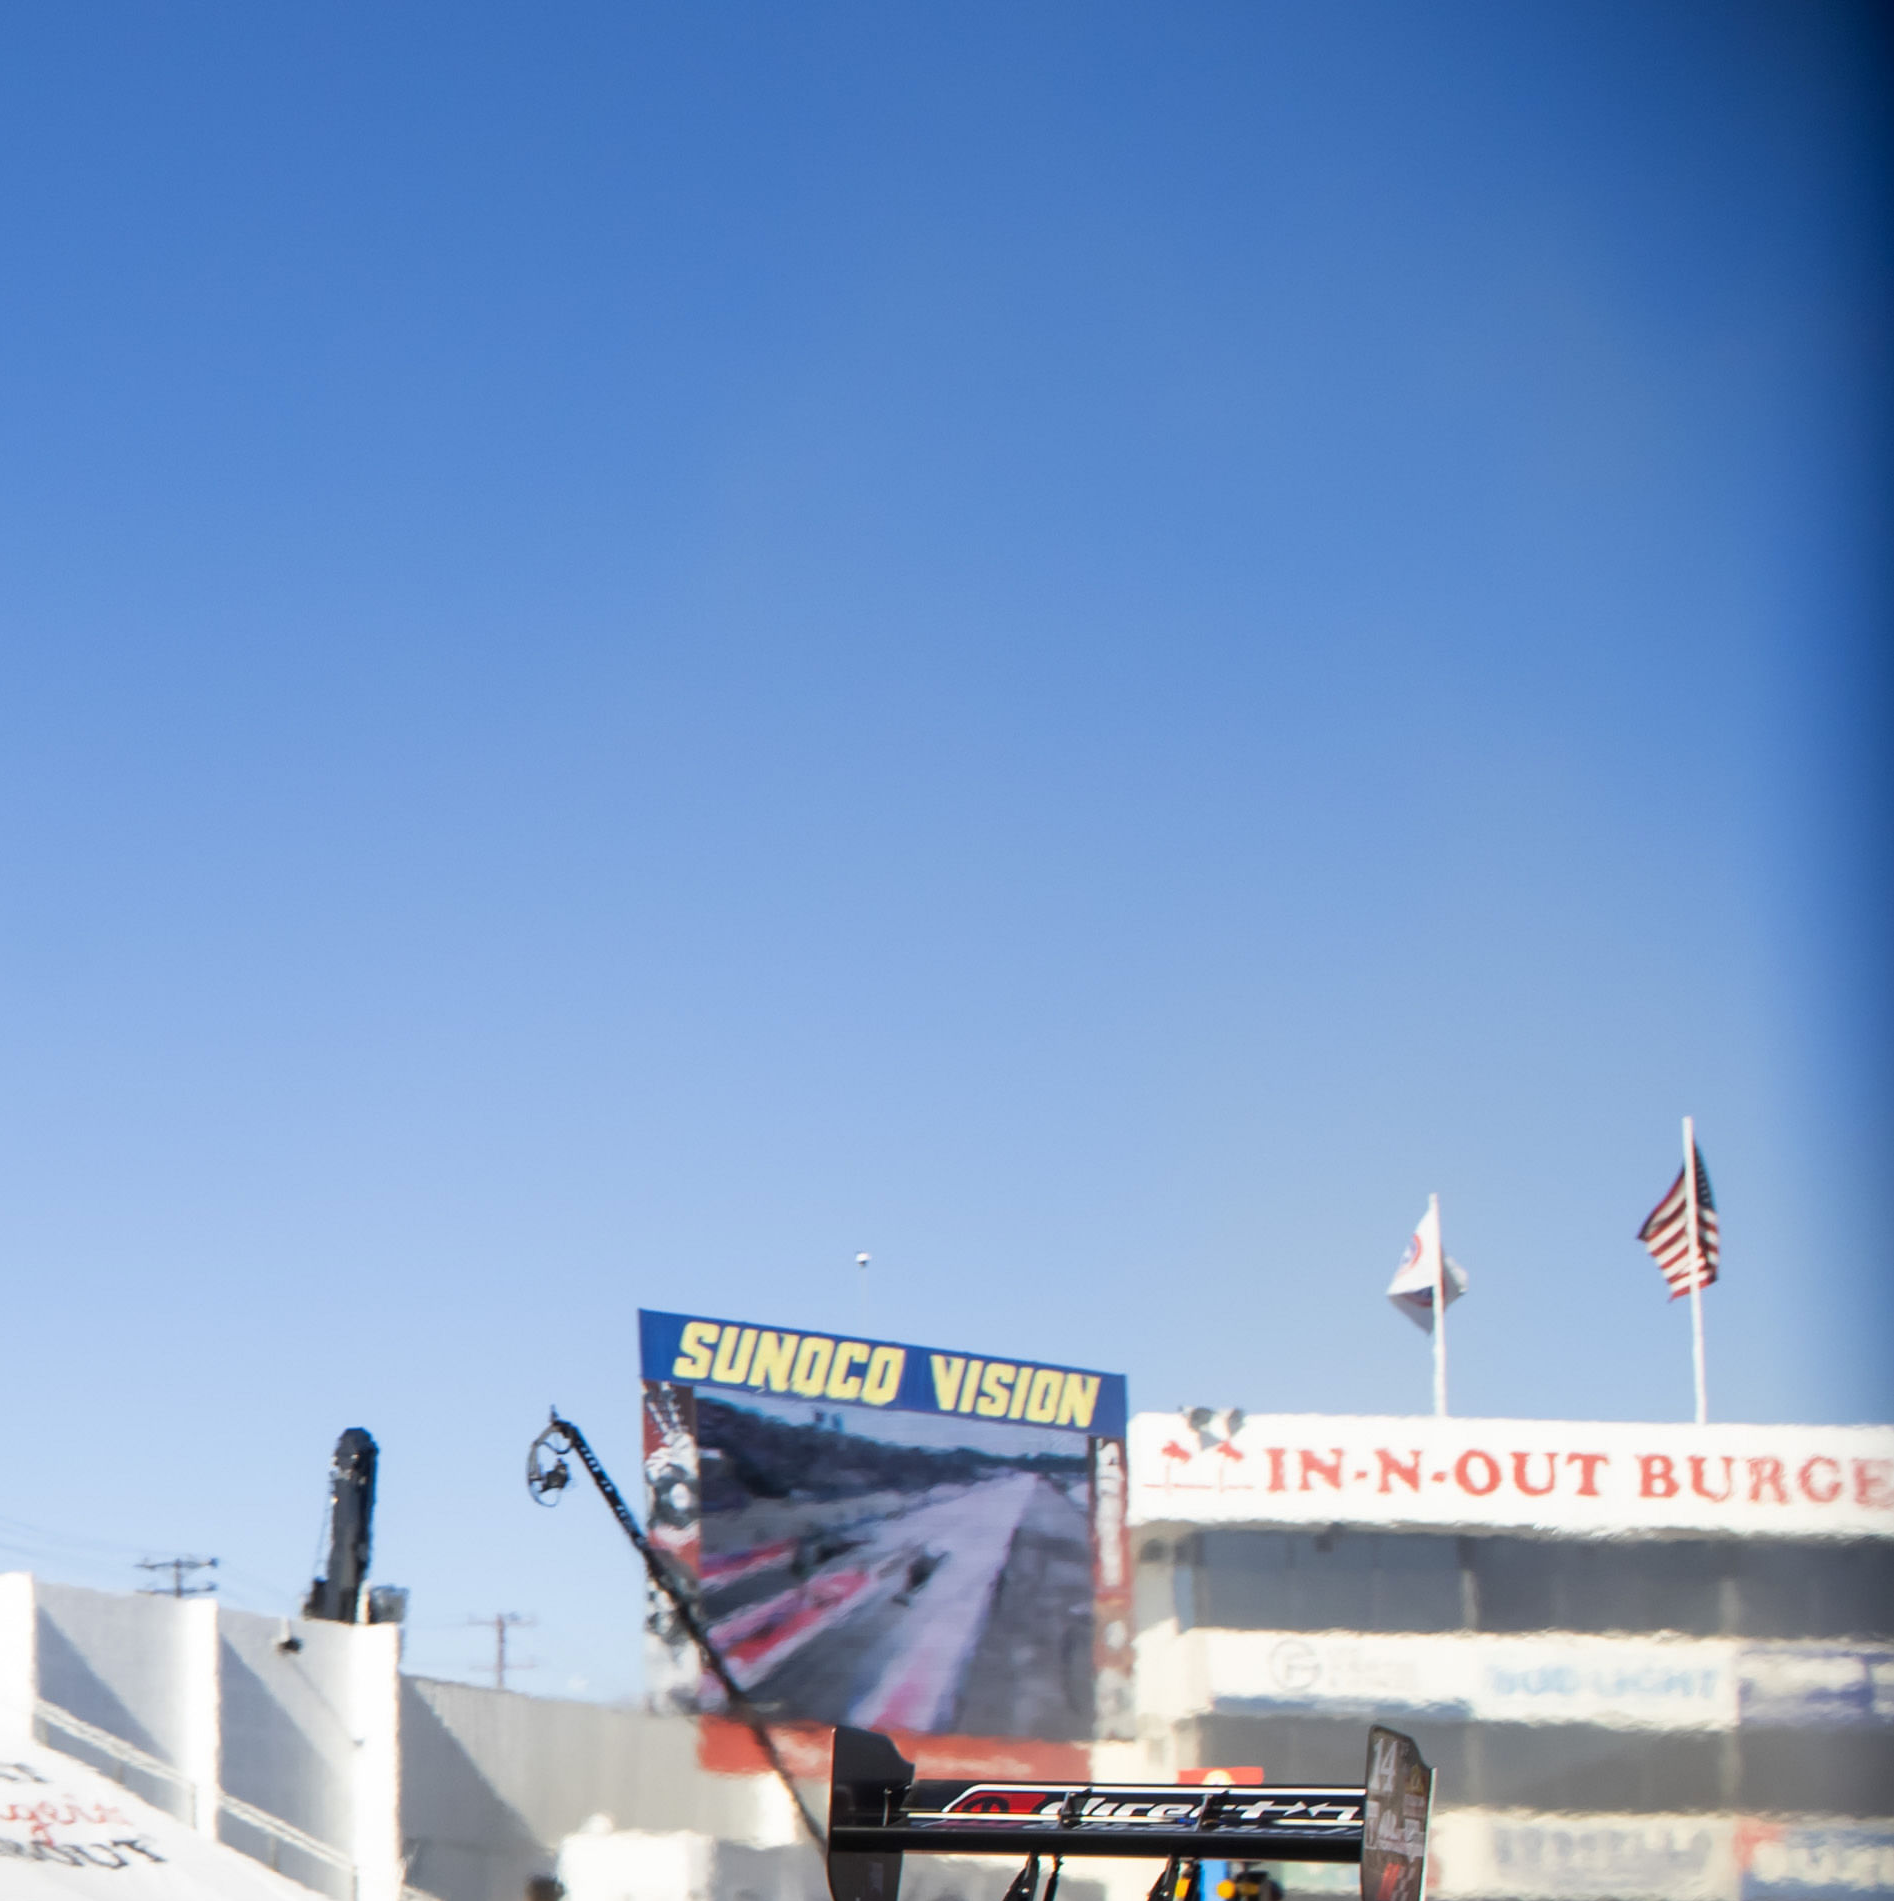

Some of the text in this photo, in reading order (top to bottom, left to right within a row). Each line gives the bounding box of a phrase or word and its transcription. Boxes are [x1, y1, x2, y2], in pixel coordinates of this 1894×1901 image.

[673, 1320, 1102, 1429] SUNOCO VISION
[1265, 1447, 1610, 1497] IN-N-OUT
